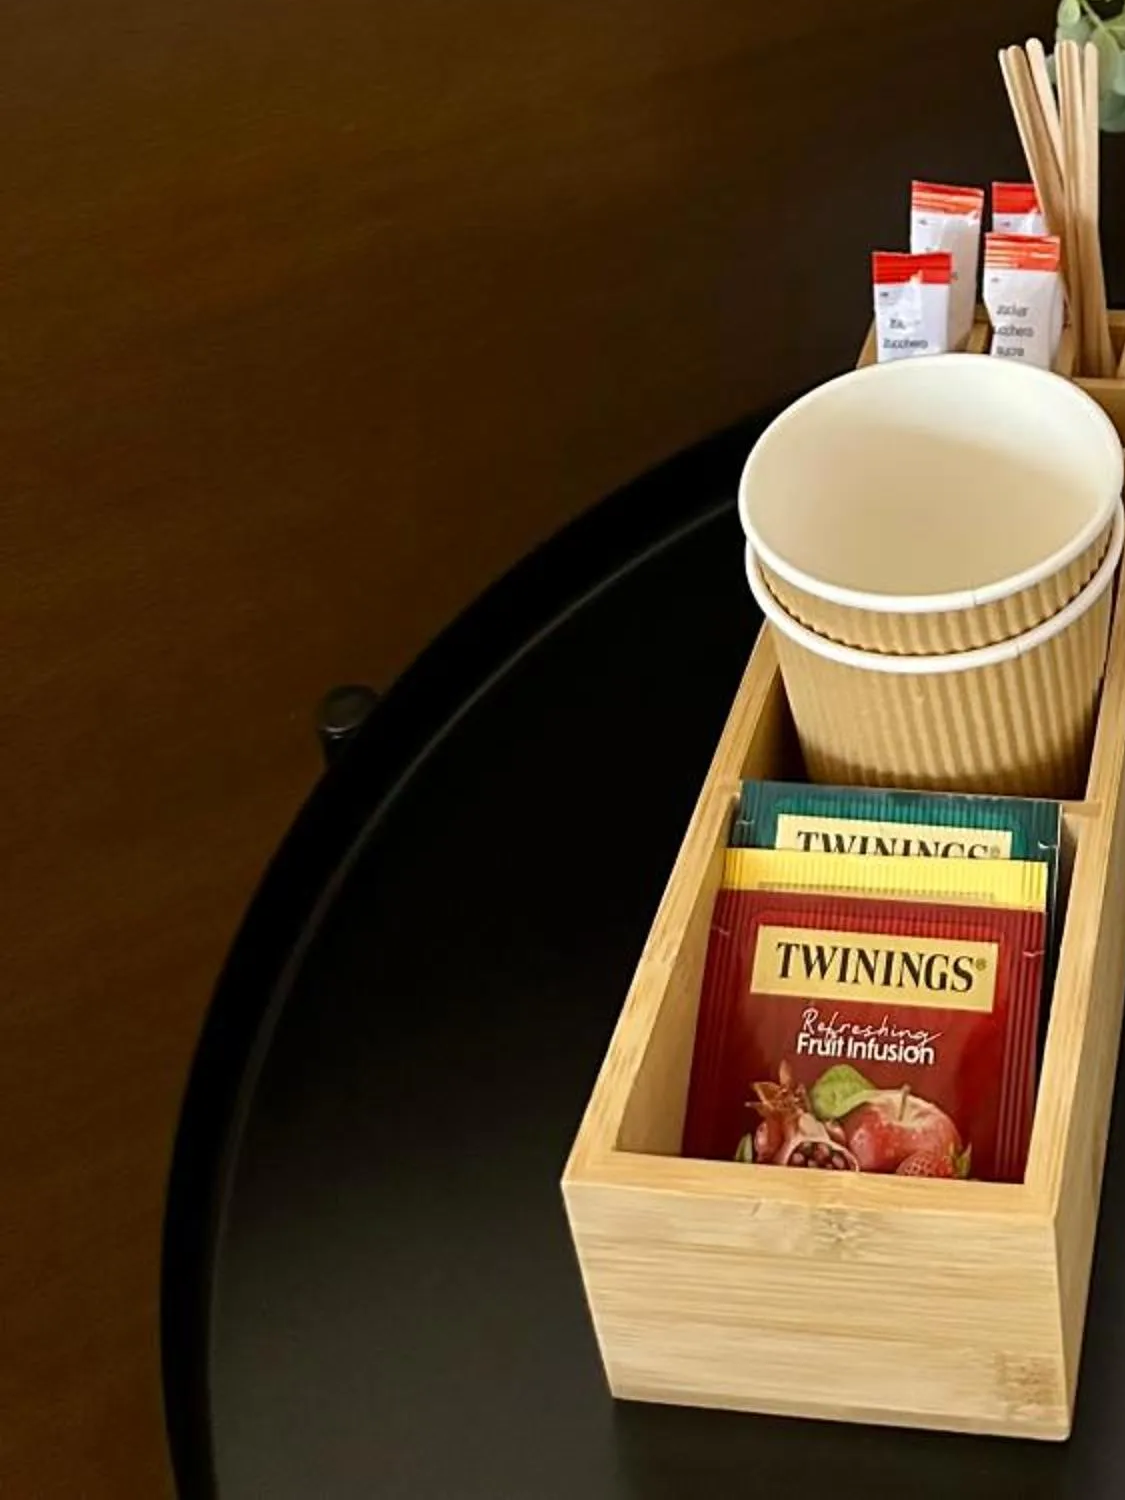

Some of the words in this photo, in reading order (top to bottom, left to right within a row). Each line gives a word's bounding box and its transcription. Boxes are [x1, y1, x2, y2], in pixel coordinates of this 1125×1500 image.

[801, 1007, 943, 1045] Refreshing
[796, 1031, 844, 1058] Fruit
[847, 1035, 935, 1066] Infusion
